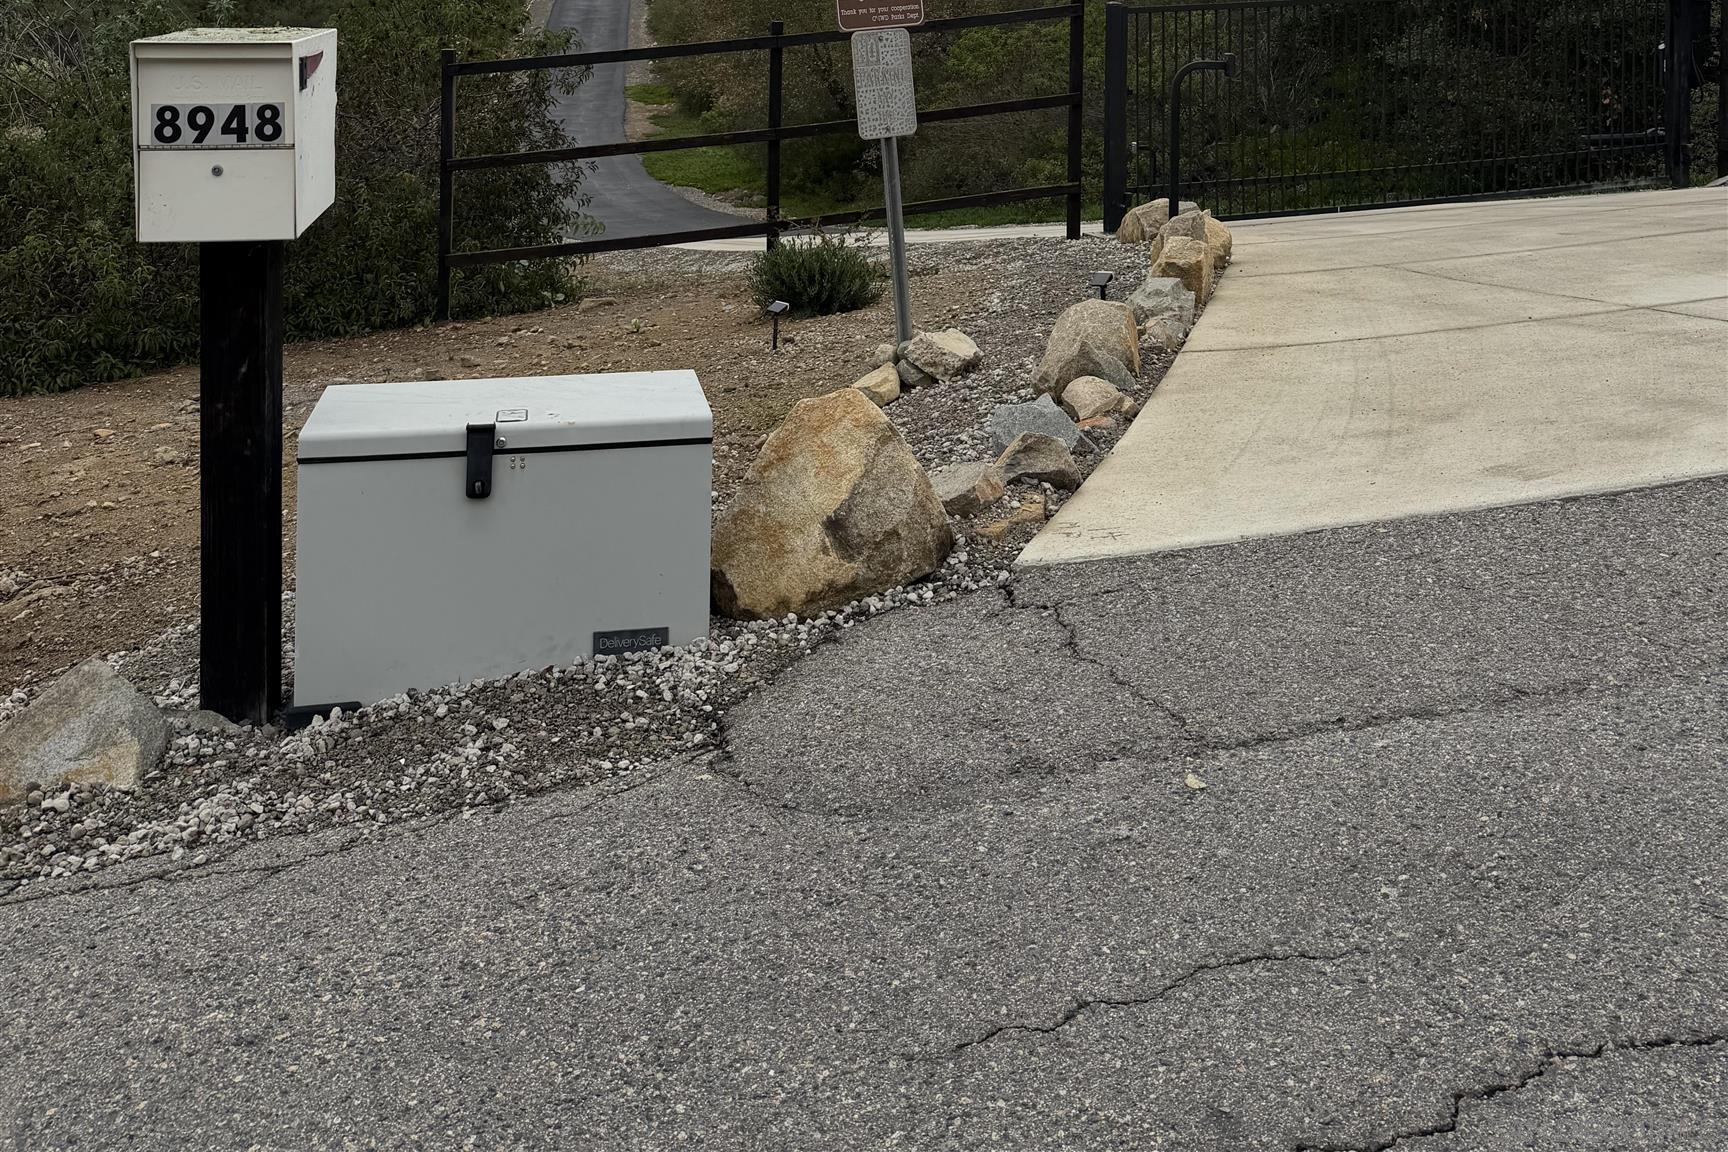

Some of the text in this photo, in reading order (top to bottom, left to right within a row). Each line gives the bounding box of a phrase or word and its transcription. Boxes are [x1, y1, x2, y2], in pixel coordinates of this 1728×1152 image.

[215, 73, 263, 90] MAIL
[153, 103, 283, 144] 8948
[600, 634, 662, 648] DeliverySafe
